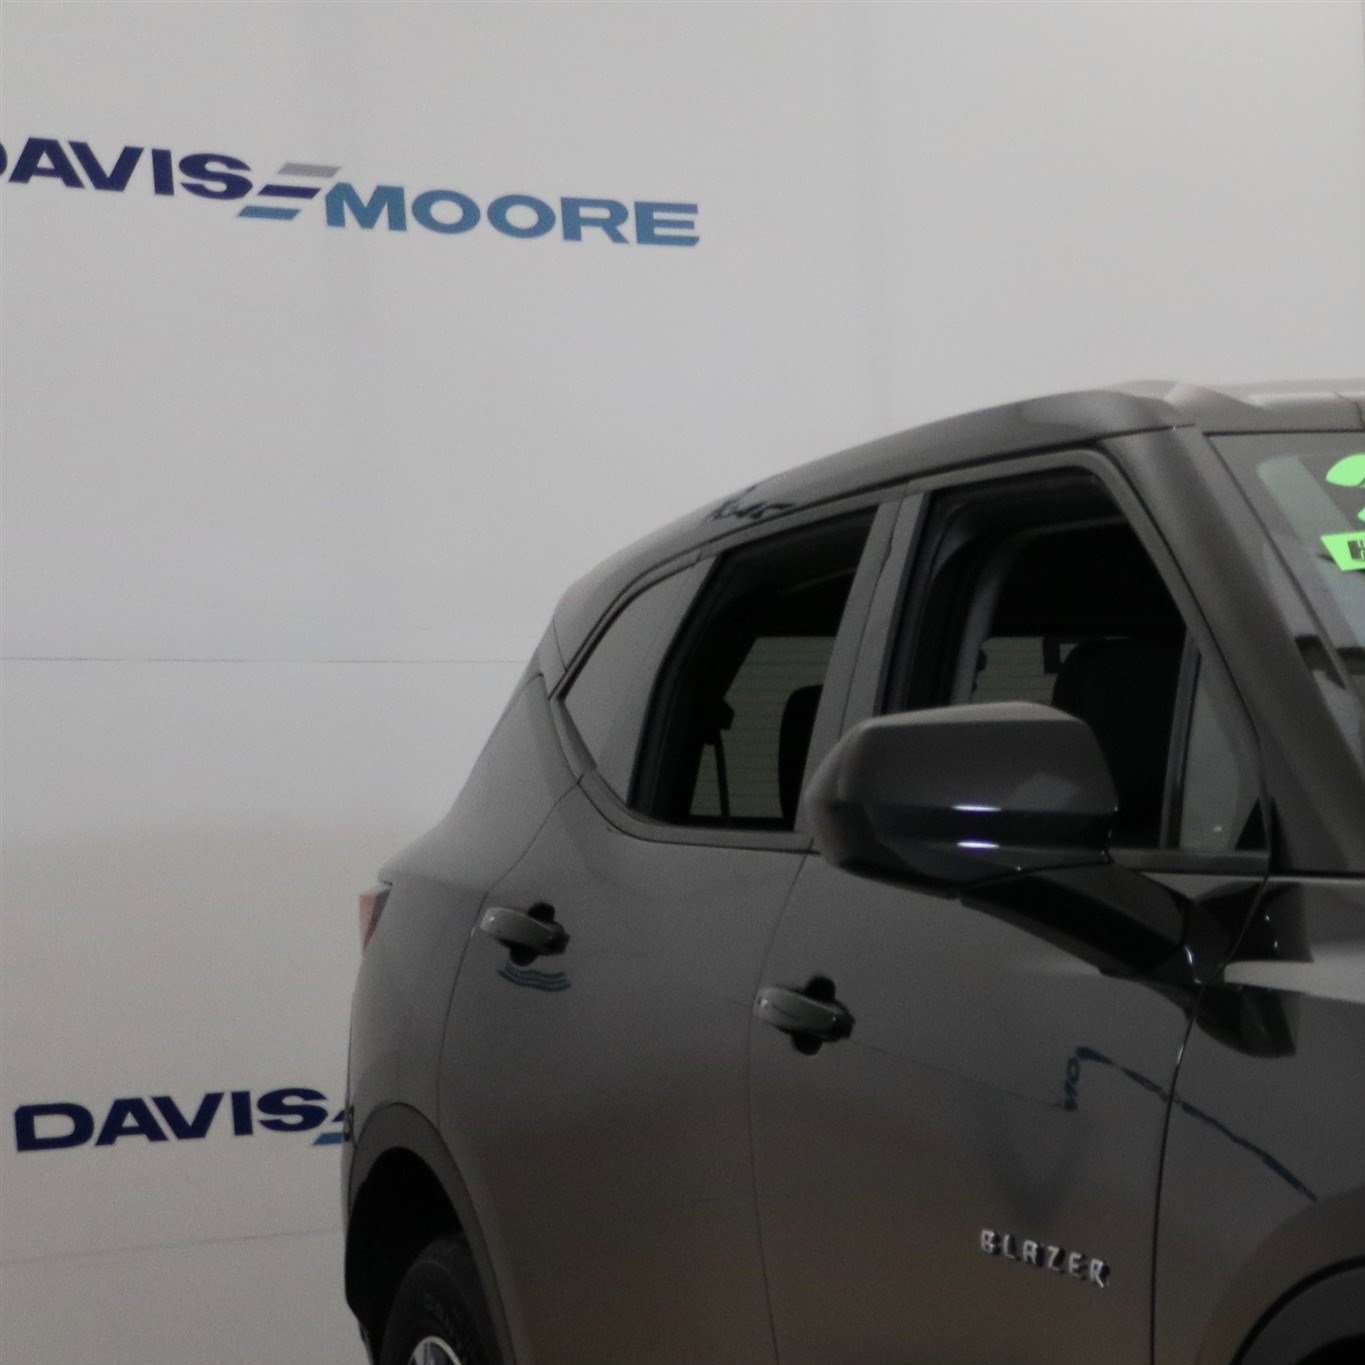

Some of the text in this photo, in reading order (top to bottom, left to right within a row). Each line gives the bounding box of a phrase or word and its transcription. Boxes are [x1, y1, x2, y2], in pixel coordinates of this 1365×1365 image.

[0, 136, 700, 247] AVIS MOORE
[13, 1086, 330, 1154] DAVIS
[980, 1229, 1109, 1289] BLAZER
